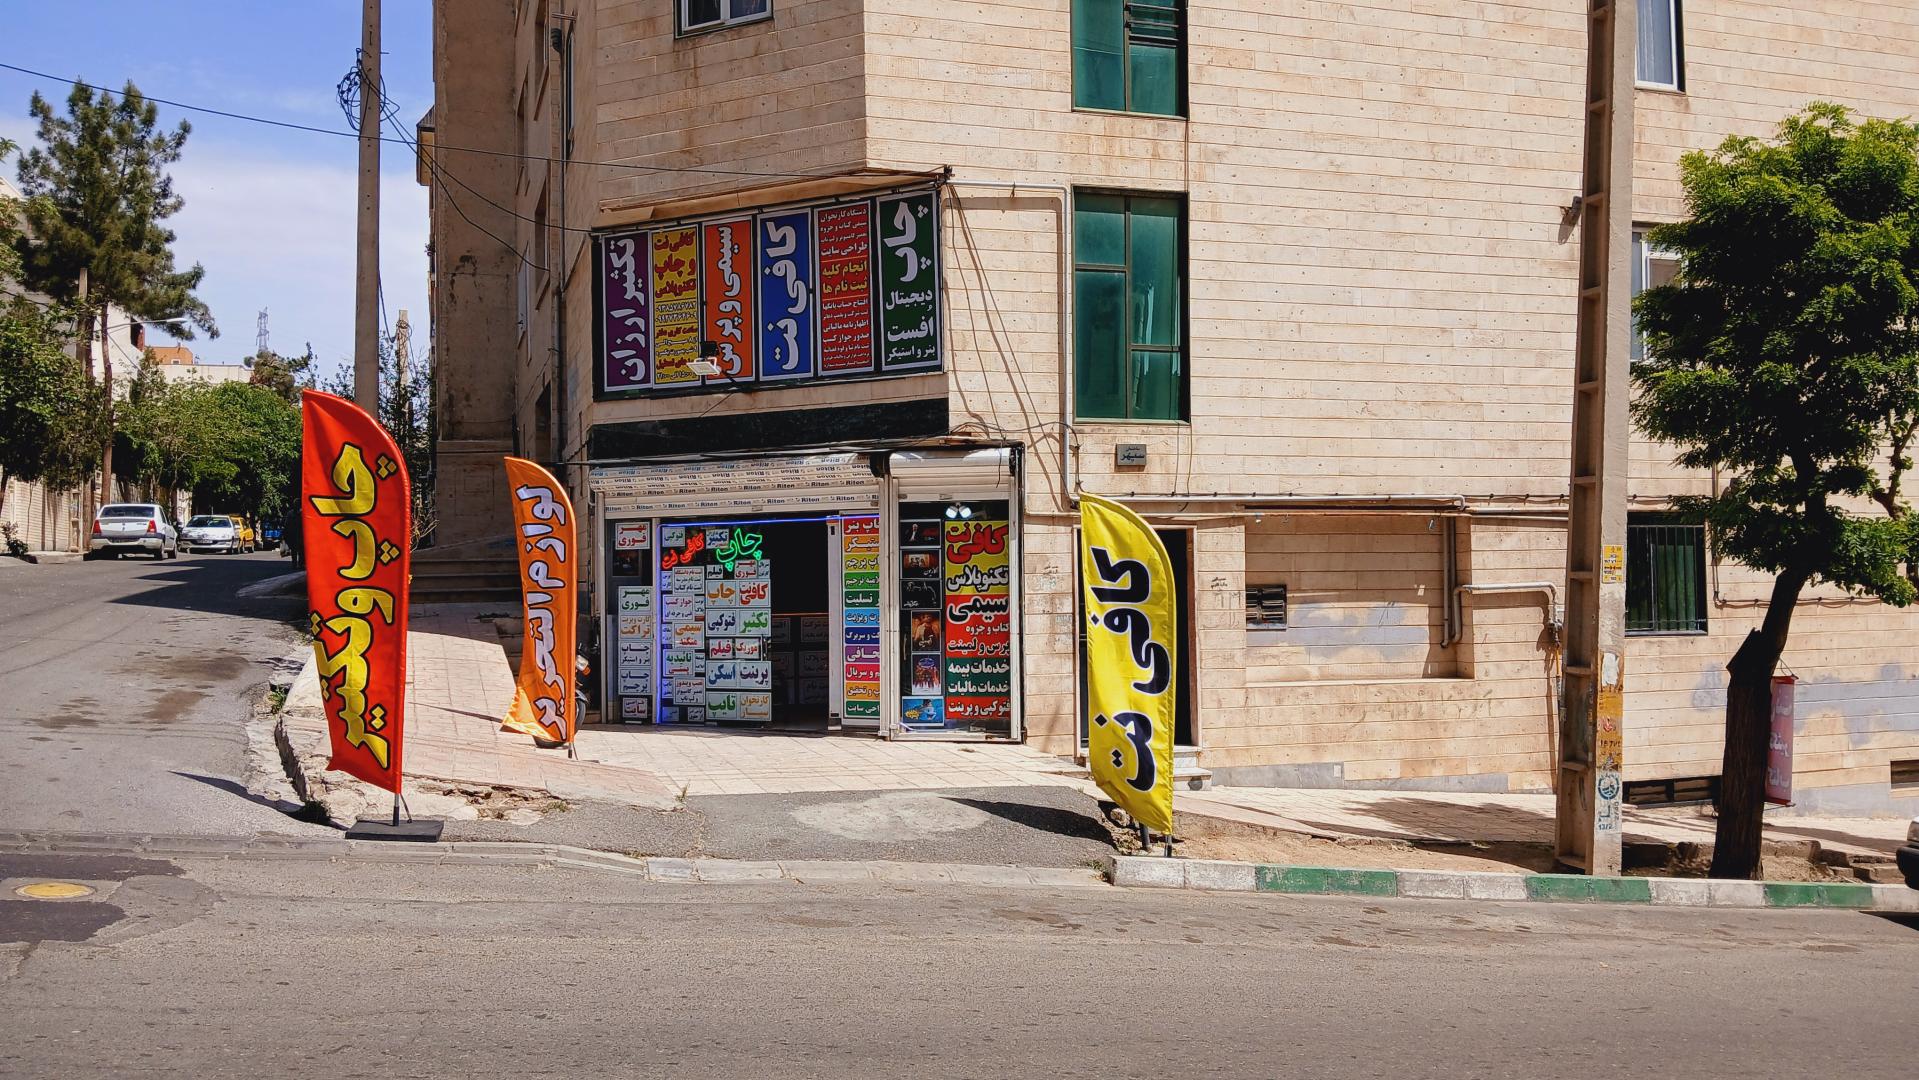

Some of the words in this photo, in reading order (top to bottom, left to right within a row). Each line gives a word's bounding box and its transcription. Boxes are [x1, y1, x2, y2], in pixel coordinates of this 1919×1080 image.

[654, 234, 669, 251] نت
[883, 201, 932, 283] چاپ
[654, 253, 685, 280] چاپ
[687, 257, 696, 276] و
[717, 226, 742, 297] سیمی
[763, 221, 807, 314] کافی
[842, 260, 867, 276] انجام
[609, 238, 645, 306] تکثیر
[822, 264, 841, 278] کلیه
[822, 282, 833, 294] ها
[834, 279, 848, 295] نام
[849, 276, 868, 291] ثبت
[718, 300, 742, 315] و
[885, 289, 933, 310] دیجیتال
[610, 308, 646, 381] ارزان
[715, 316, 743, 376] پرس
[767, 318, 799, 370] نت
[924, 344, 936, 357] بنر
[887, 344, 915, 362] استیکر
[916, 348, 922, 358] و
[310, 442, 400, 580] چاپ
[845, 520, 859, 533] بنر
[862, 518, 880, 533] اپ
[945, 521, 972, 543] نت
[515, 484, 566, 589] لوازم
[618, 532, 647, 547] فوری
[707, 530, 729, 546] تکثیر
[946, 523, 1009, 565] کافی
[716, 527, 763, 572] چاپ
[846, 537, 880, 553] ستیکر
[707, 566, 723, 578] فیلم
[735, 566, 757, 578] فوری
[845, 558, 868, 570] پرچم
[946, 564, 1009, 592] تکنوپلاس
[707, 581, 736, 605] چاپ
[739, 582, 752, 595] نت
[740, 582, 769, 605] کافی
[337, 587, 394, 624] و
[621, 597, 650, 610] فوری
[845, 592, 873, 606] تسلیت
[846, 612, 868, 624] ویزیت
[946, 595, 1009, 625] سیمی
[707, 612, 736, 632] فتوکپی
[739, 611, 769, 634] تکثیر
[1089, 545, 1172, 695] کافی
[965, 624, 985, 635] جزوه
[987, 627, 991, 635] و
[992, 622, 1010, 635] کتاب
[866, 633, 871, 641] و
[621, 643, 650, 656] چاپ
[710, 639, 732, 657] فیلم
[847, 646, 880, 662] حافی
[946, 637, 978, 655] لمینت
[978, 642, 986, 655] و
[986, 640, 1010, 656] پرس
[526, 590, 568, 741] التحریر
[846, 666, 868, 679] سریال
[947, 662, 971, 677] بیمه
[970, 658, 1009, 674] خدمات
[620, 671, 650, 682] چاپ
[708, 663, 736, 686] اسکن
[740, 665, 769, 686] پرینت
[869, 669, 874, 679] و
[310, 613, 390, 770] تکثیر
[622, 682, 648, 693] پرچم
[847, 686, 867, 696] تحقیق
[867, 689, 872, 697] و
[948, 680, 978, 696] مالیات
[978, 680, 1009, 693] خدمات
[707, 694, 736, 717] تایپ
[740, 695, 769, 707] کارتخوان
[847, 703, 865, 713] سایت
[948, 701, 974, 716] پرینت
[973, 704, 979, 713] و
[624, 705, 646, 717] سایت
[1093, 709, 1157, 793] نت
